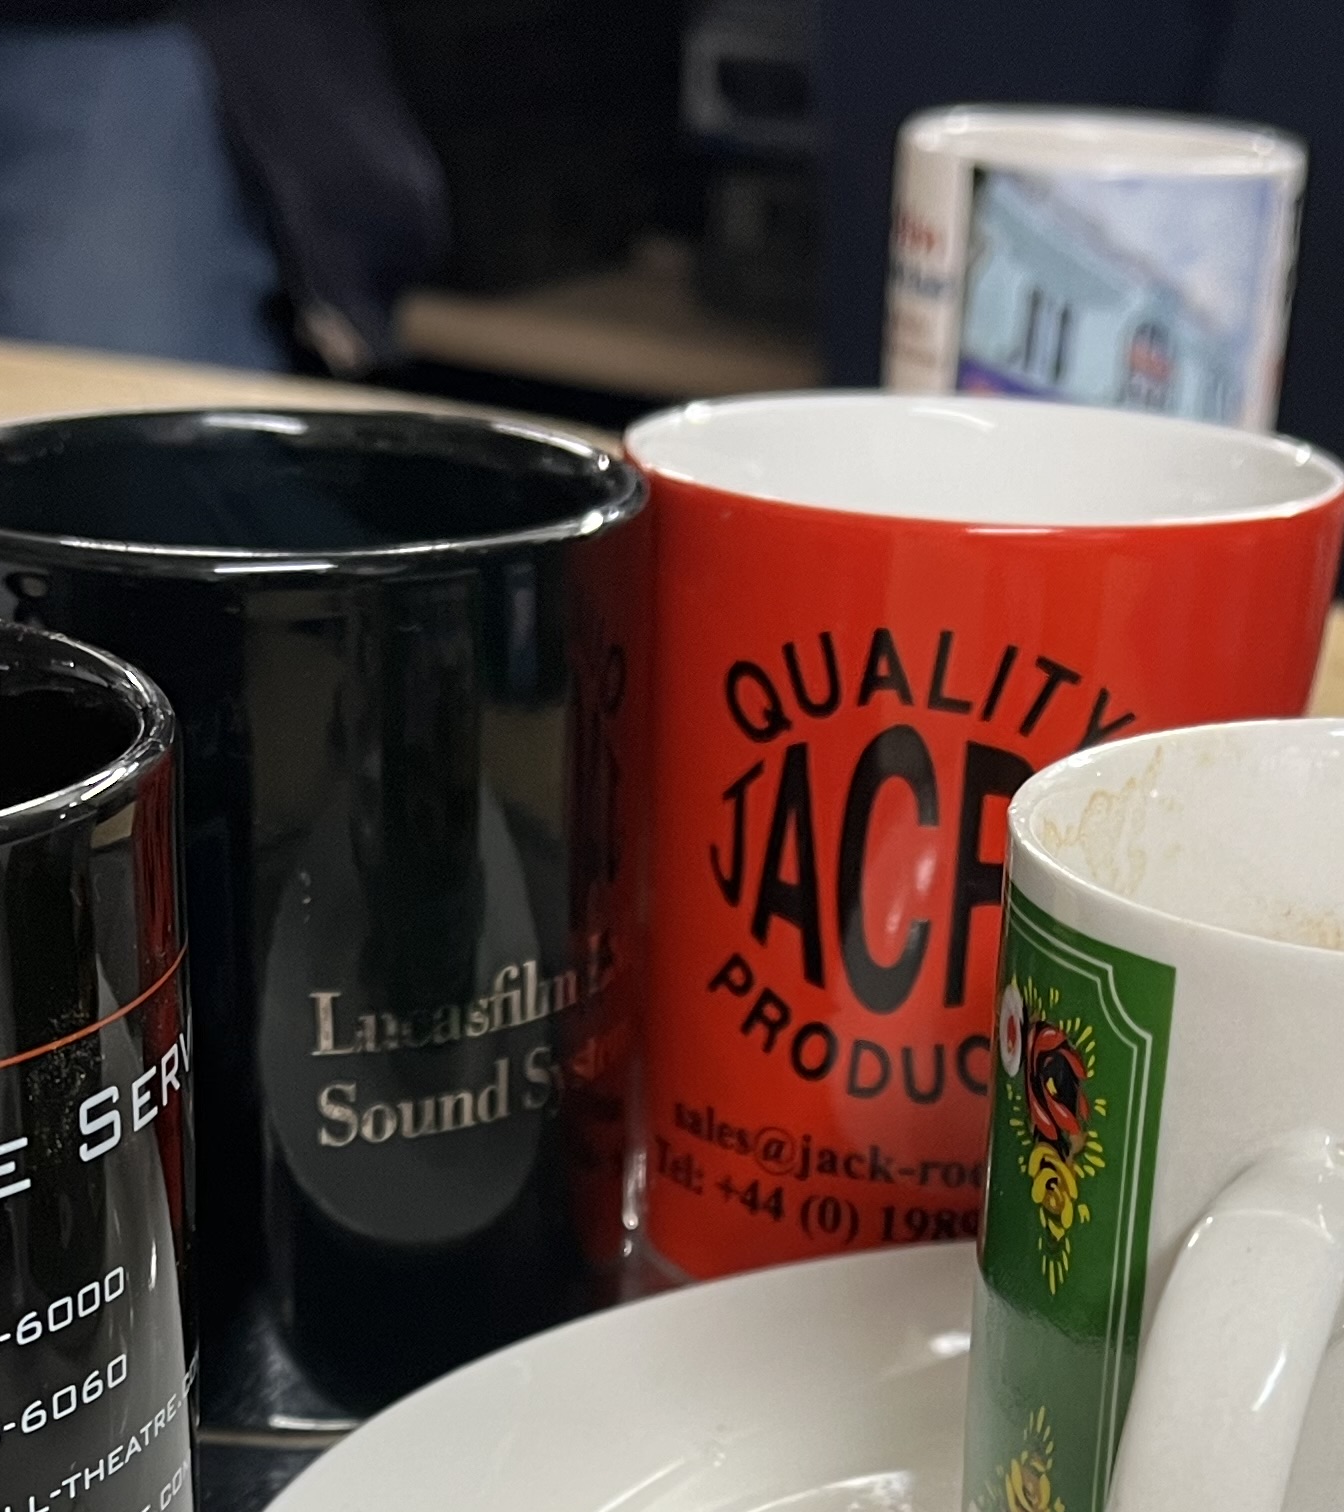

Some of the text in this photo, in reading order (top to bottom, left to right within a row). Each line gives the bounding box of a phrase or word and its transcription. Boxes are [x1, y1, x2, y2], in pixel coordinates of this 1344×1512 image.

[722, 627, 1136, 752] QUALITY
[317, 1057, 510, 1148] Sound
[716, 1178, 784, 1222] +44
[800, 1194, 859, 1244] (0)
